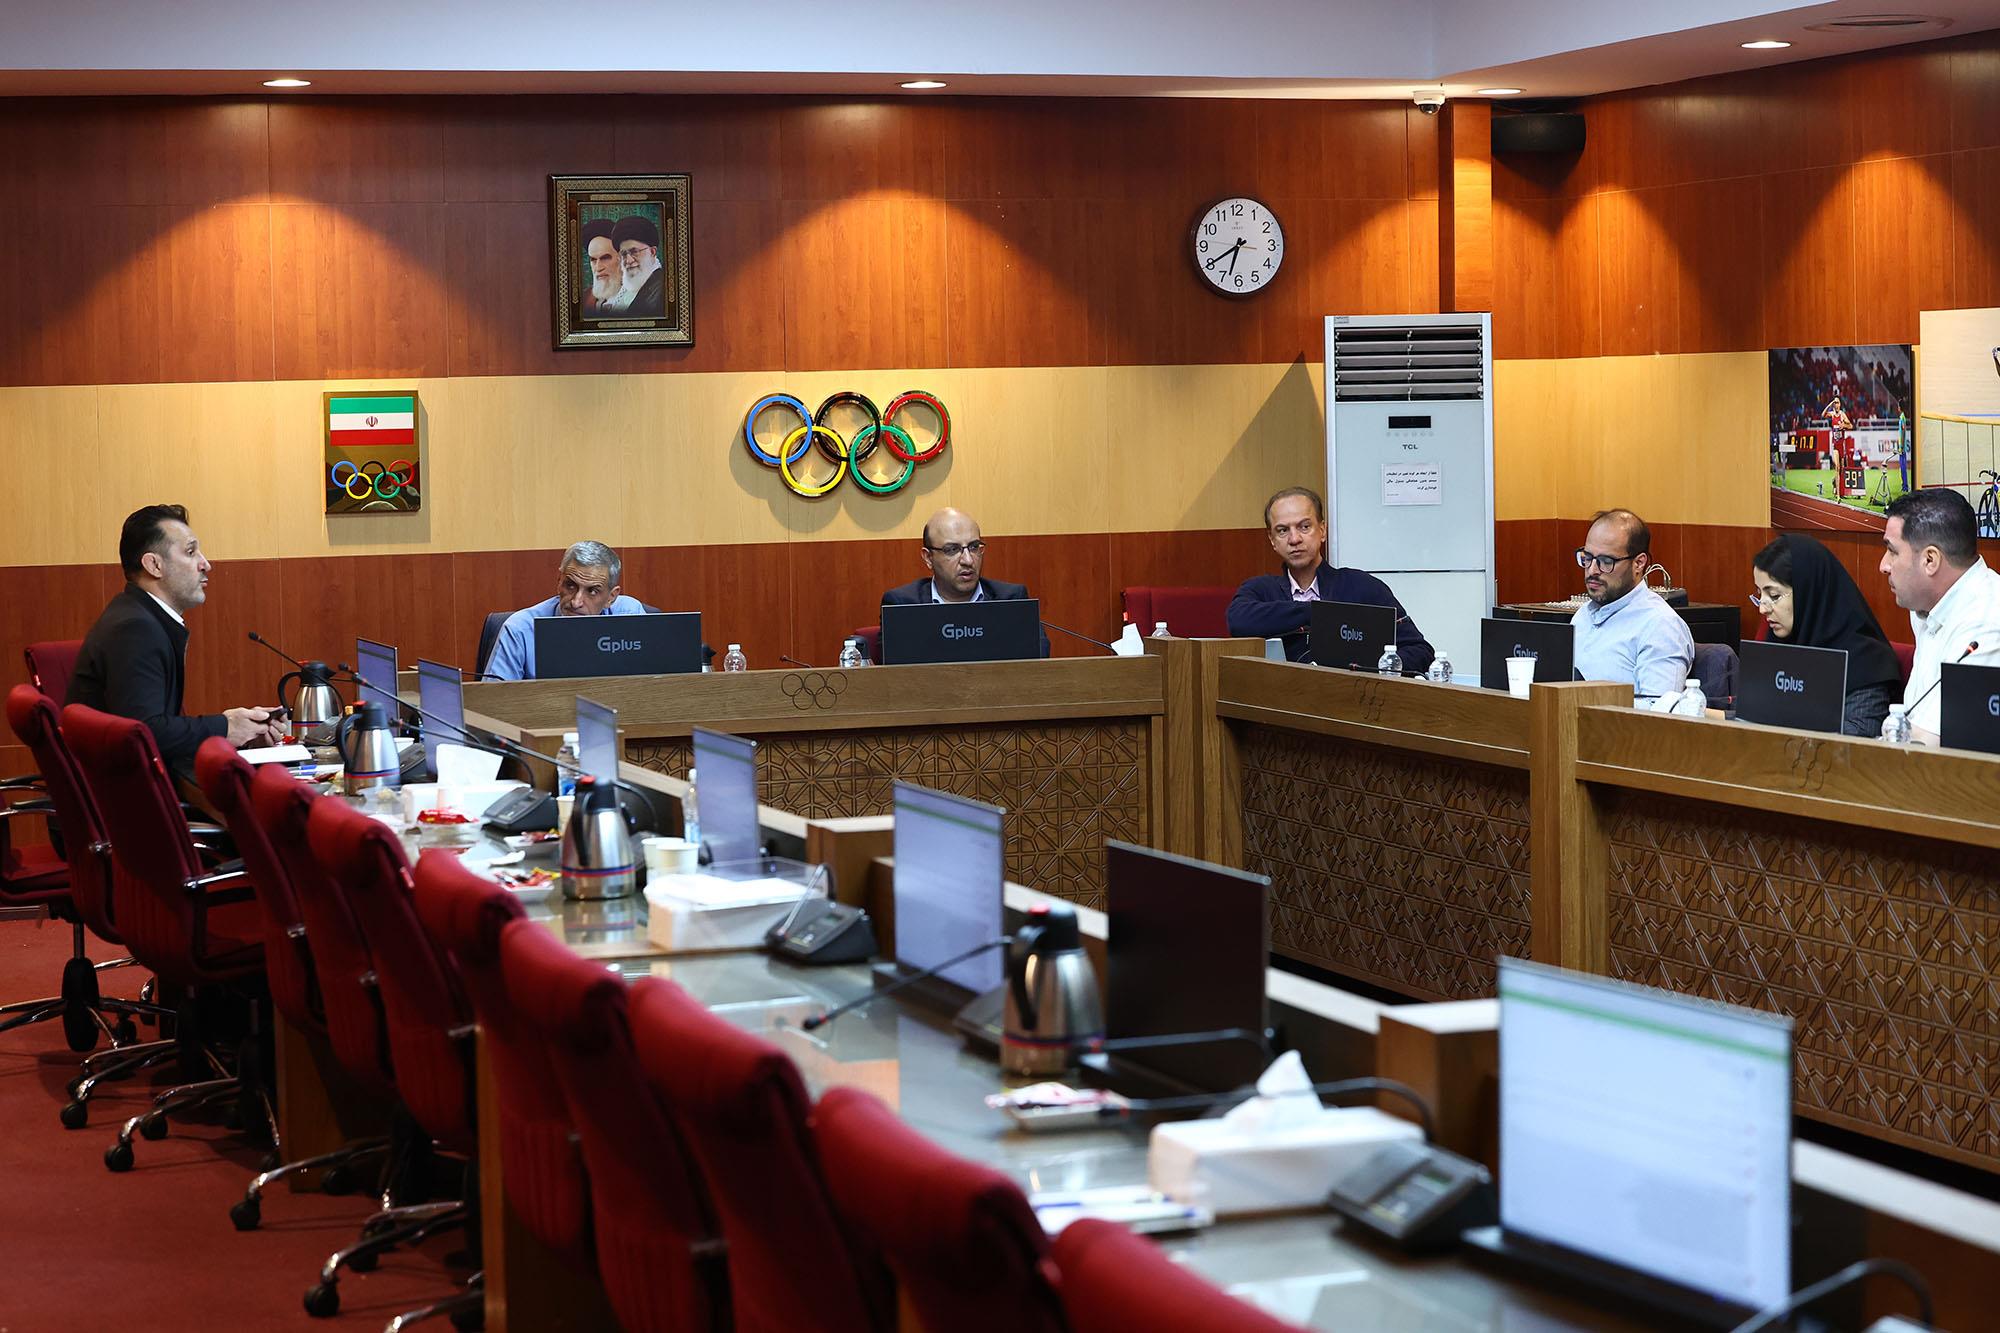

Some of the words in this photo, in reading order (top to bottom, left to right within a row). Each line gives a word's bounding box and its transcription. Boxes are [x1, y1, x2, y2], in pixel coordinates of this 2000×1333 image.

[1216, 209, 1226, 222] 11
[1230, 204, 1243, 216] 12
[1251, 209, 1256, 221] 1
[1204, 223, 1217, 236] 10
[1262, 221, 1271, 233] 2
[1199, 240, 1208, 252] 9
[1267, 239, 1276, 251] 3
[1206, 257, 1216, 270] 8
[1262, 257, 1271, 269] 4
[1219, 270, 1227, 282] 7
[1234, 275, 1243, 287] 6
[1251, 270, 1259, 283] 5
[942, 623, 984, 640] Gplus
[1340, 624, 1363, 642] Gplus
[597, 636, 642, 653] Gplus
[1775, 671, 1804, 693] Gplus
